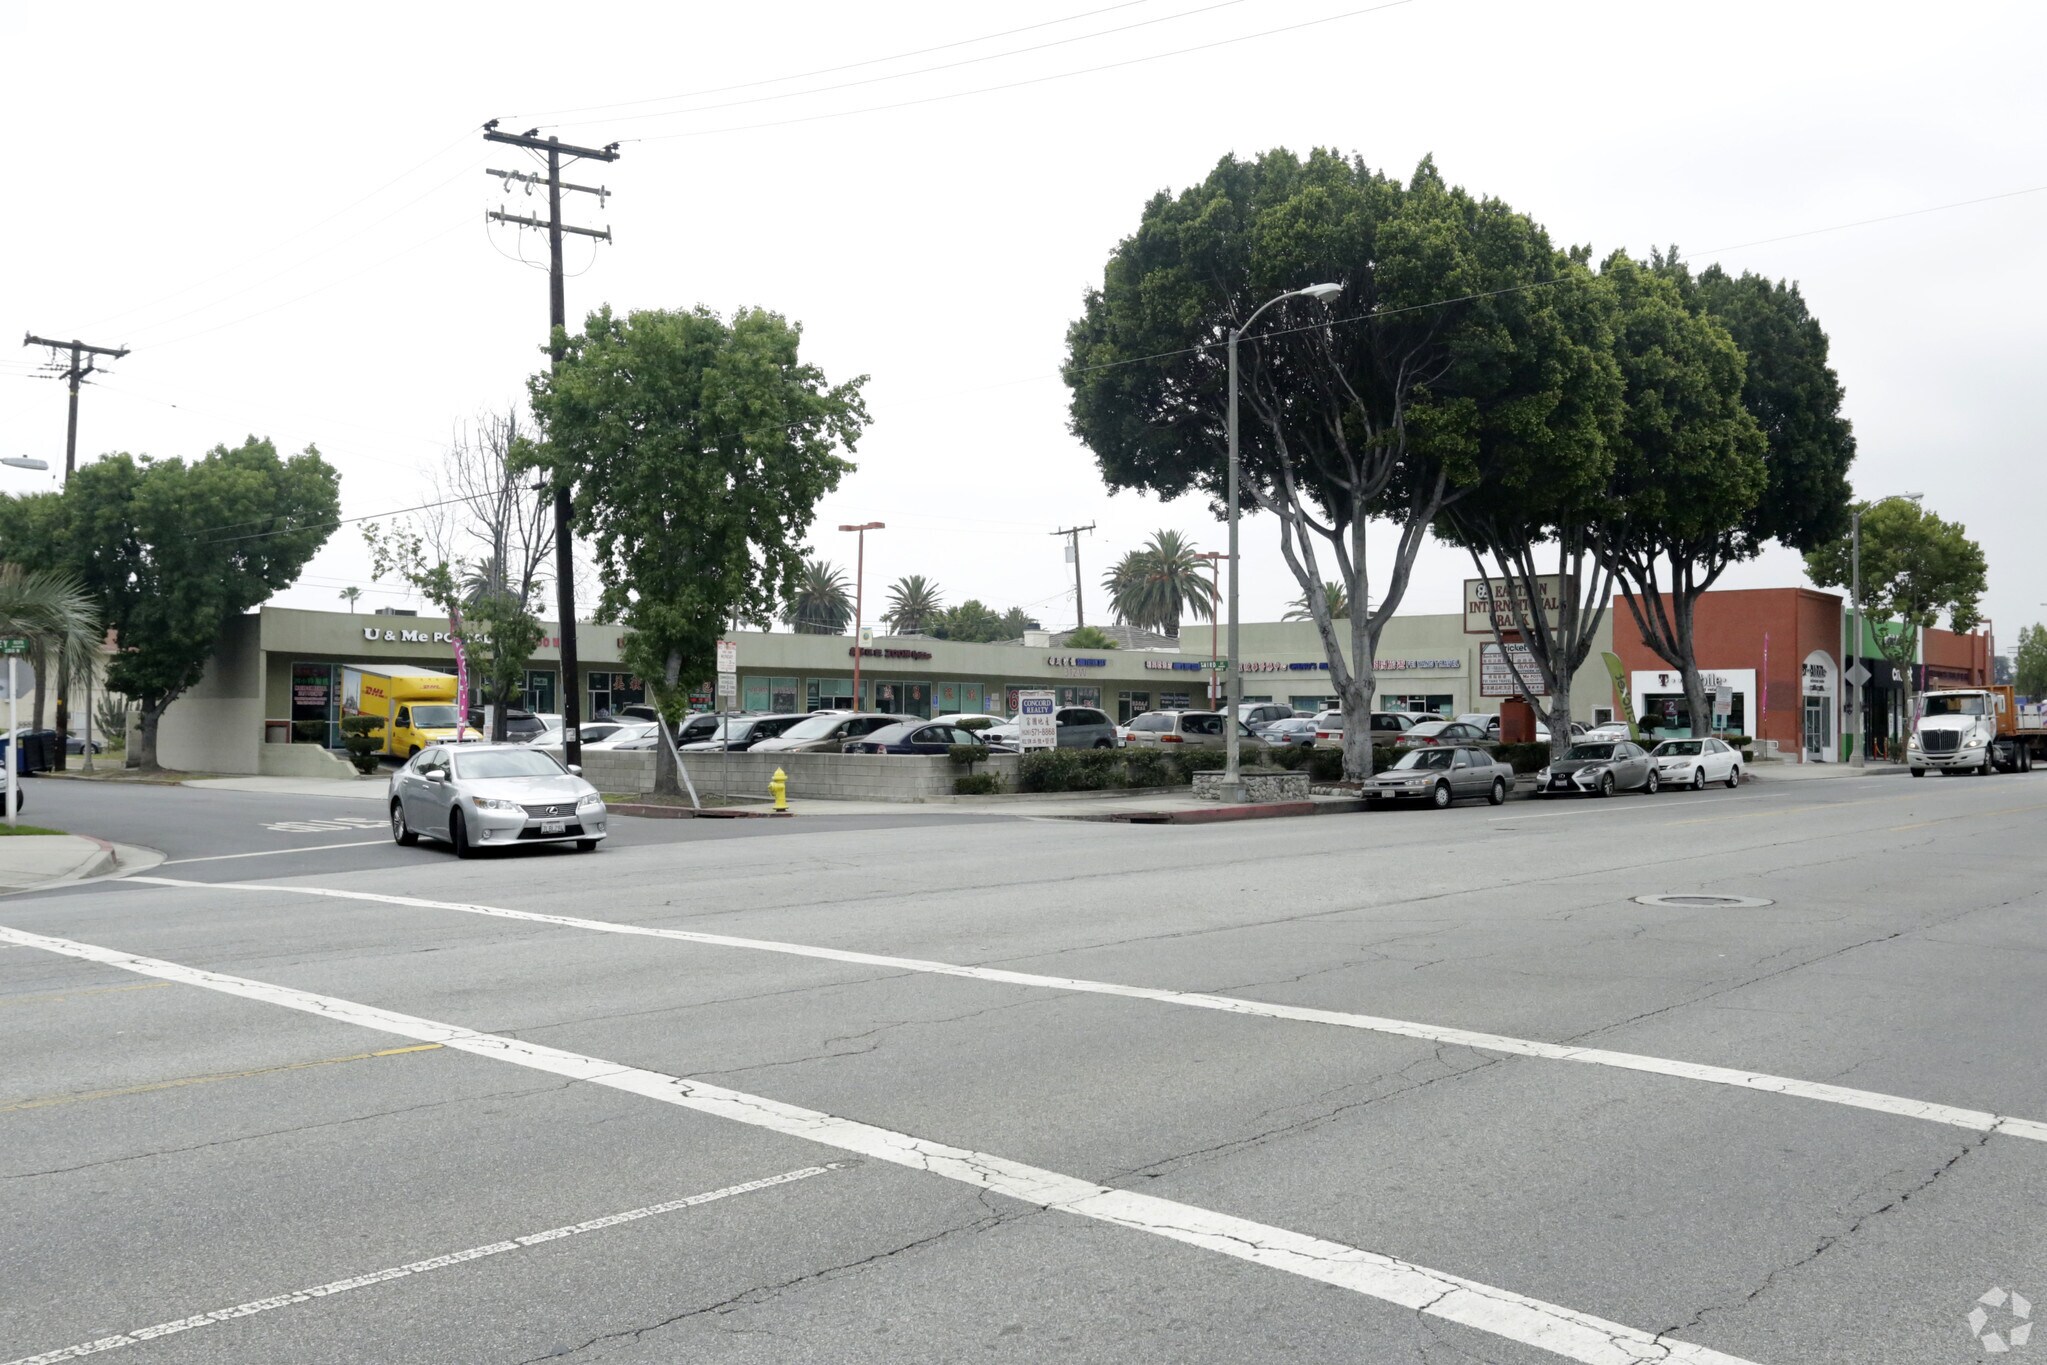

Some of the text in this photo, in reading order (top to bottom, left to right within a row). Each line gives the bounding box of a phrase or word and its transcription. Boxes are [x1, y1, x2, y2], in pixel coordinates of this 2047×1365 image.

[1495, 583, 1547, 598] EATN
[1497, 613, 1530, 626] BAK
[364, 628, 380, 640] U
[384, 630, 396, 641] &
[401, 630, 429, 642] Me
[1503, 643, 1527, 652] ricket
[365, 686, 384, 698] DHL
[1023, 699, 1051, 708] CONCORD
